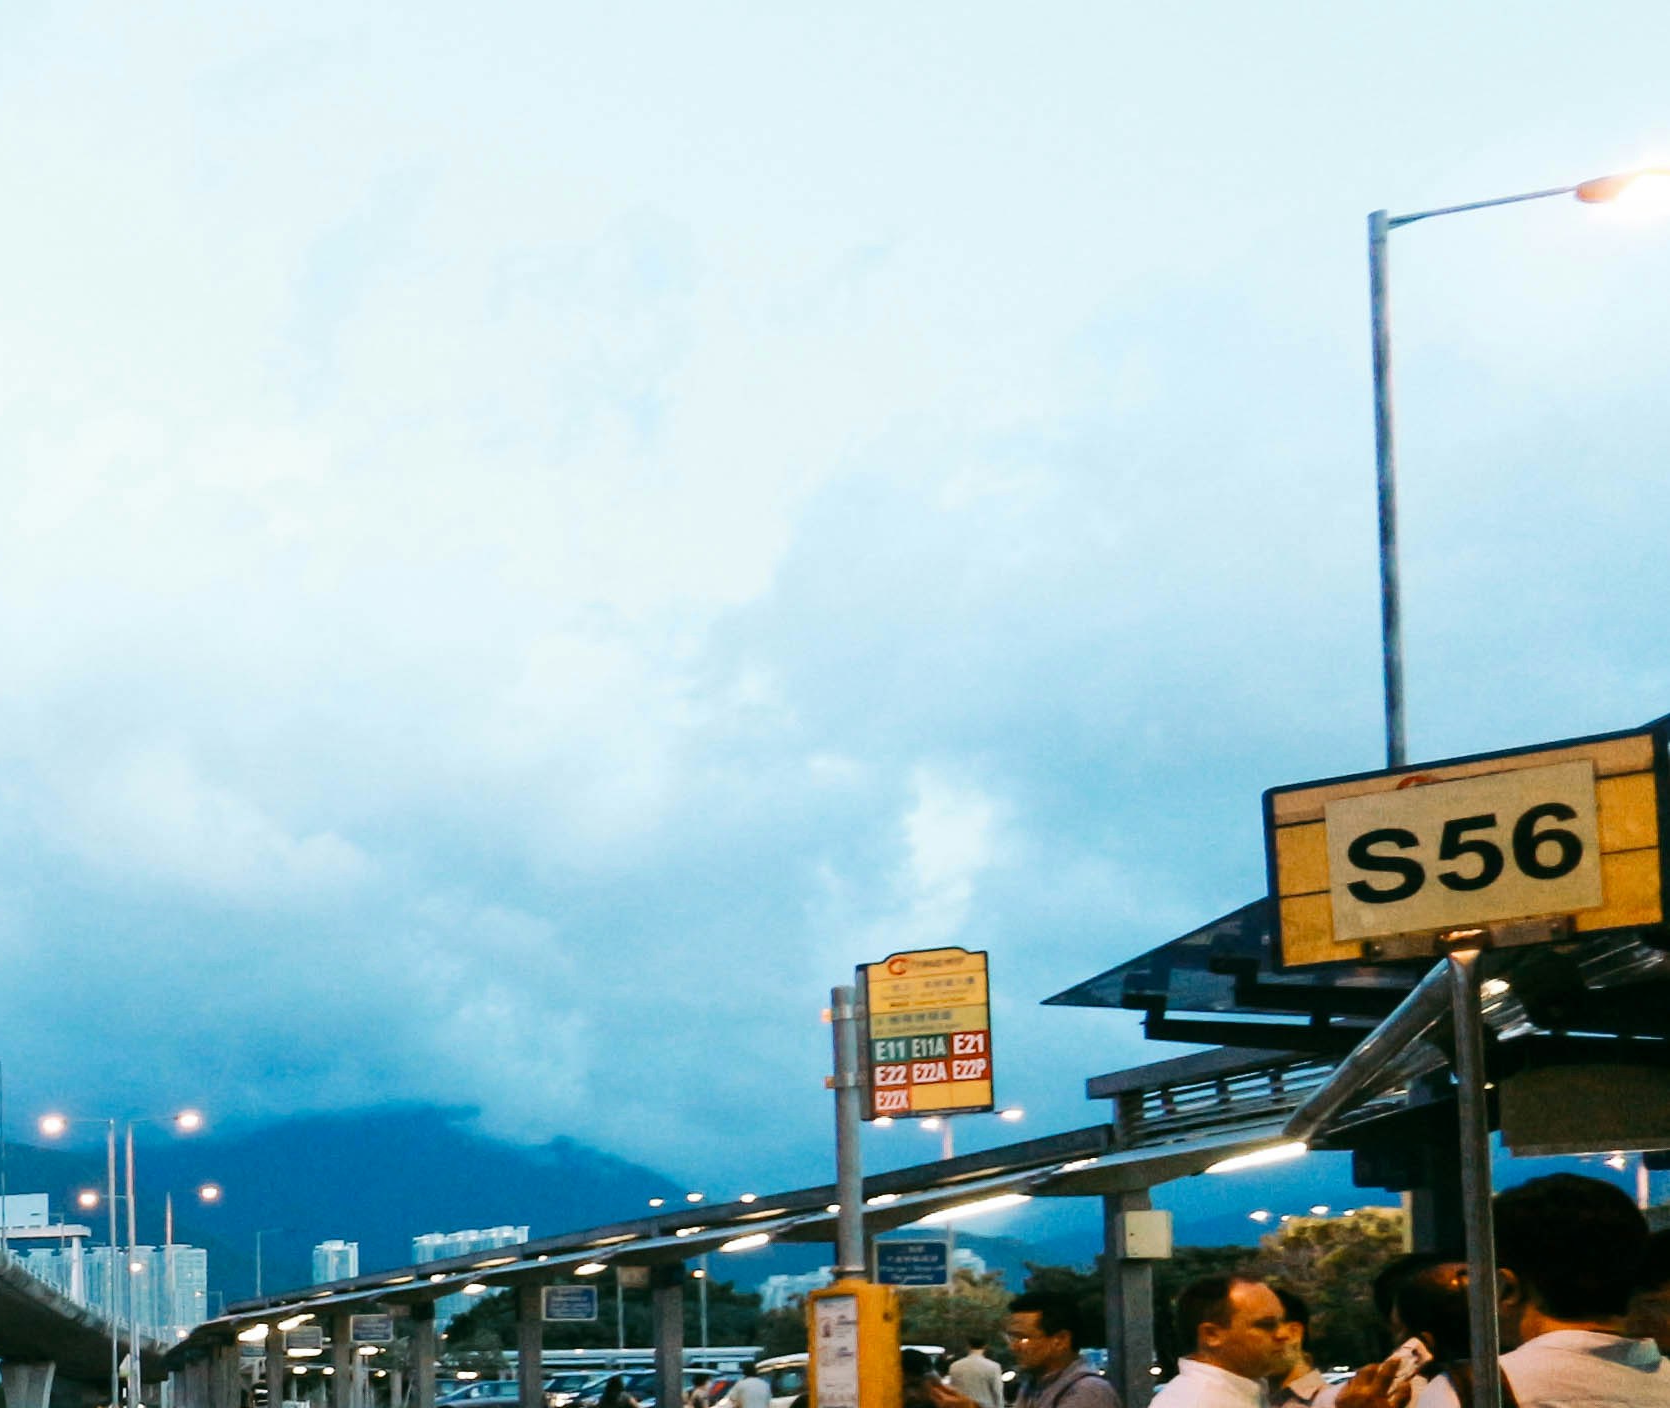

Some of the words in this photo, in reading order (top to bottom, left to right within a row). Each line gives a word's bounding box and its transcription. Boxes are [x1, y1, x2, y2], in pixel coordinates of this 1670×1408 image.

[1346, 801, 1584, 904] S56
[874, 1040, 906, 1061] E11
[911, 1035, 948, 1059] E11A
[952, 1032, 985, 1055] E21
[874, 1064, 908, 1087] E22
[911, 1061, 948, 1084] E22A
[952, 1057, 987, 1080] E22P
[874, 1088, 909, 1111] E22X
